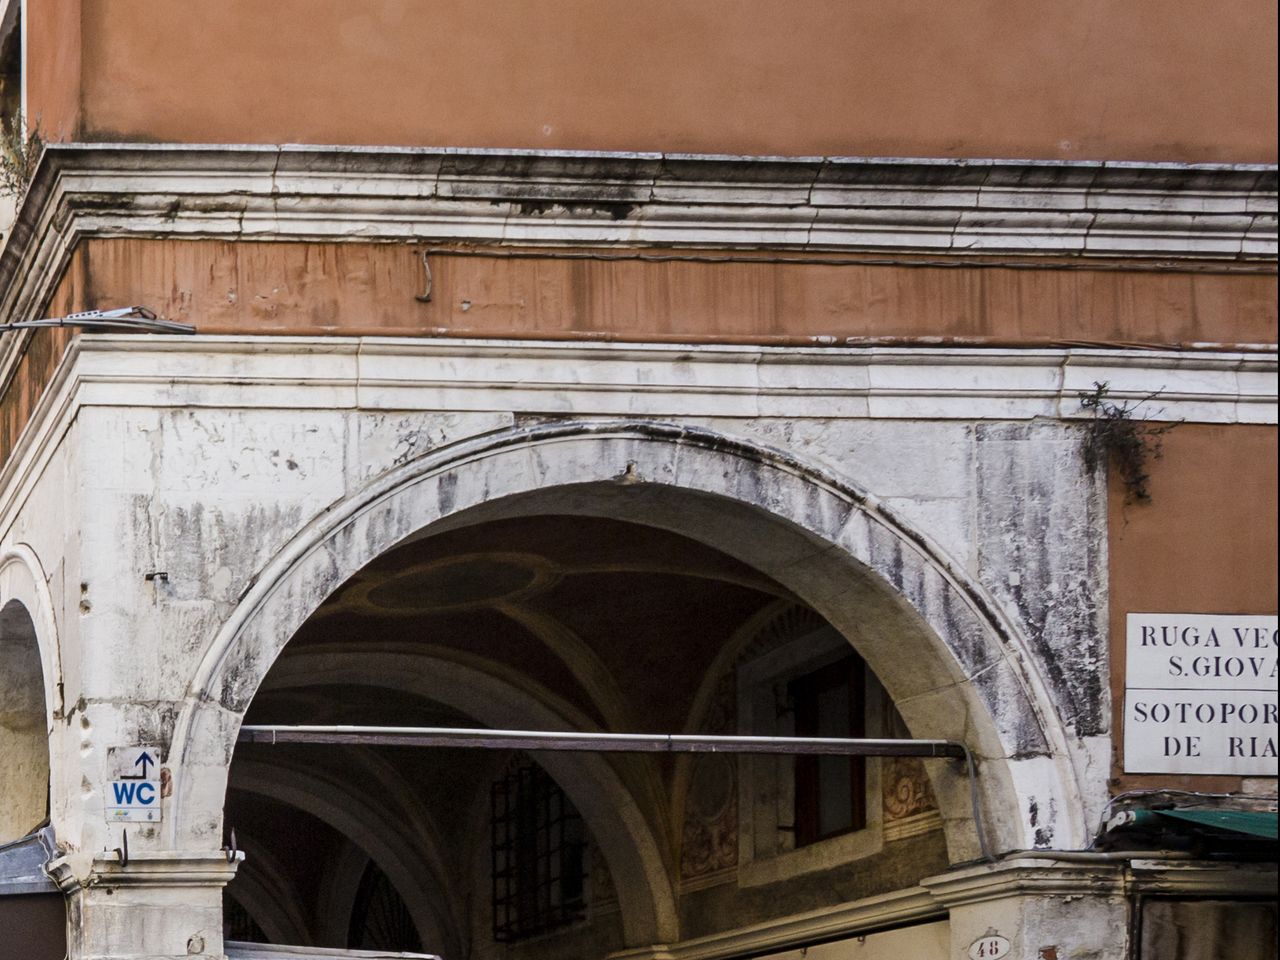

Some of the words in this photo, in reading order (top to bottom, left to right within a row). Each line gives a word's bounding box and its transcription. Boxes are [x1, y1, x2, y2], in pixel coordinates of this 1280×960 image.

[1141, 626, 1221, 648] RUGA
[1134, 702, 1278, 724] SOTOPOR
[1164, 736, 1201, 757] DE
[1228, 736, 1278, 758] RIA
[112, 782, 155, 805] WC
[976, 940, 999, 958] 48
